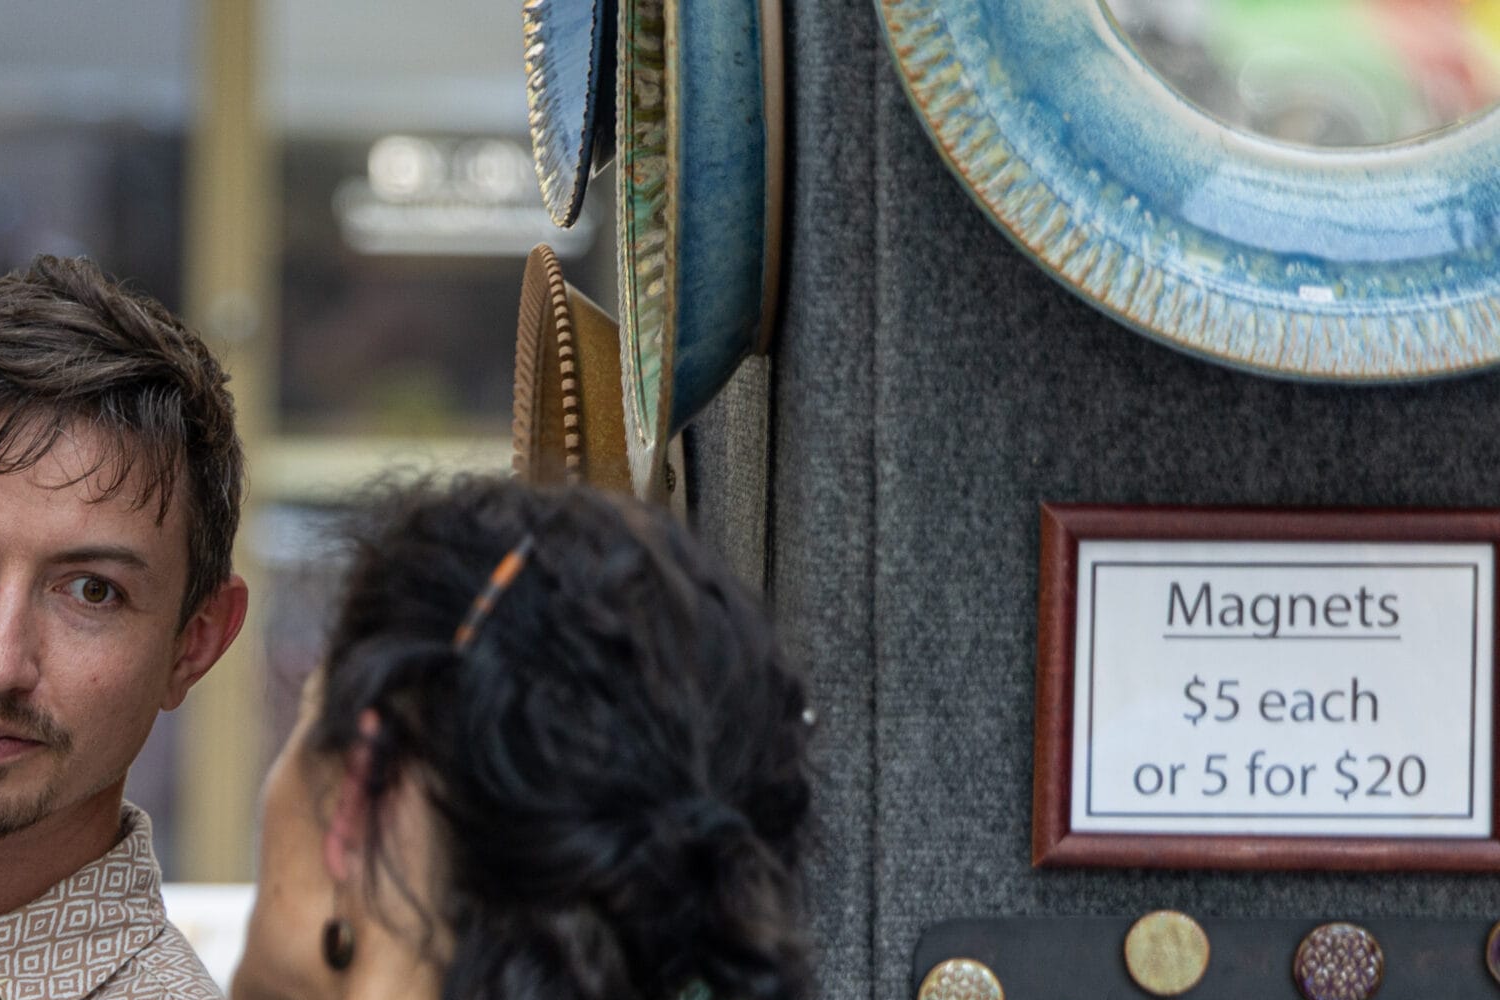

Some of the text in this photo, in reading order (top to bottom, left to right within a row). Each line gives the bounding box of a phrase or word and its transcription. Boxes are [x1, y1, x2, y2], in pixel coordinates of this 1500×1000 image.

[1166, 581, 1400, 638] Magnets
[1182, 674, 1379, 725] $5 each
[1133, 749, 1428, 801] or 5 for $20
